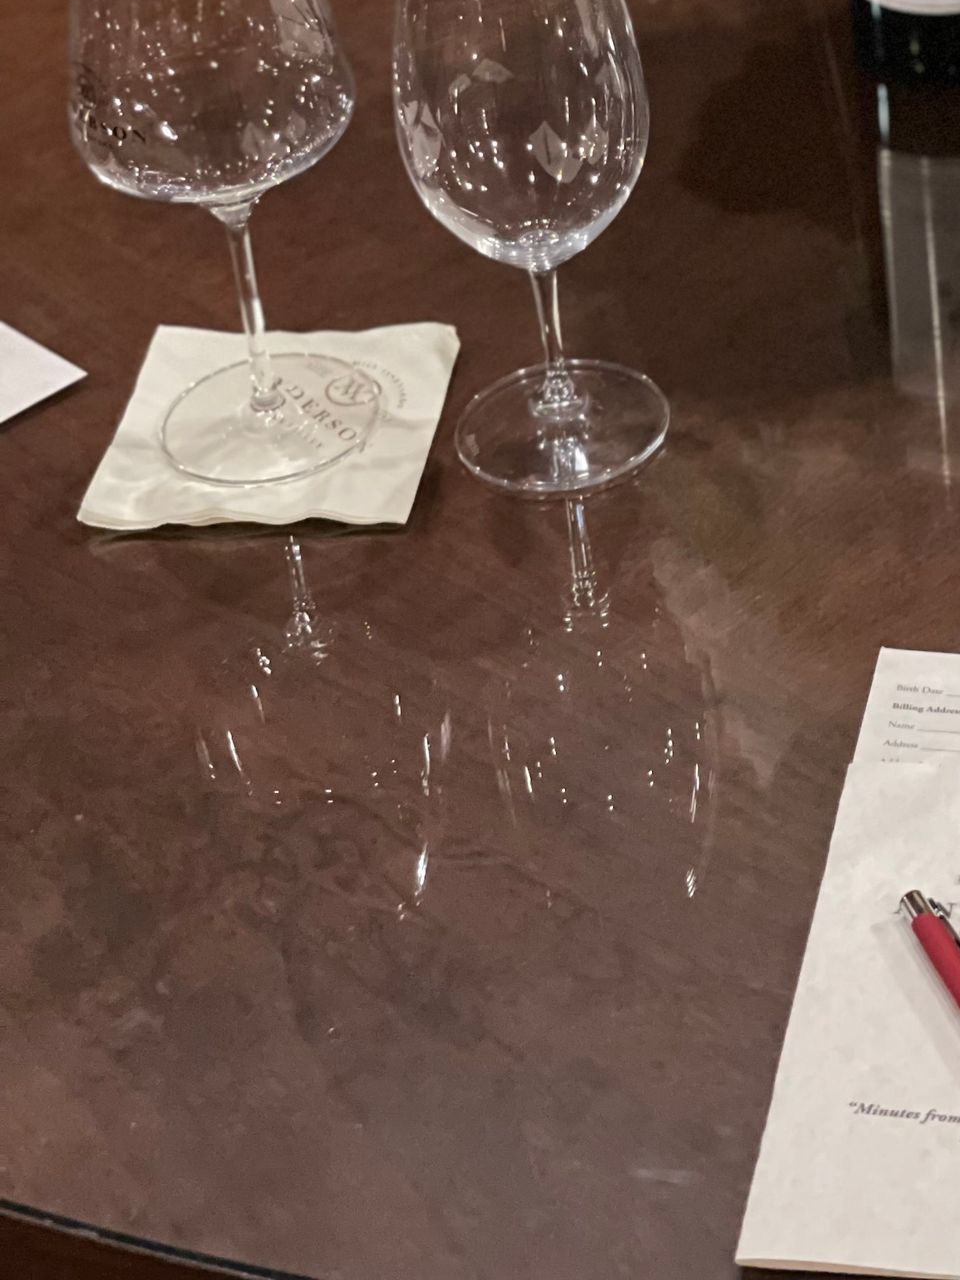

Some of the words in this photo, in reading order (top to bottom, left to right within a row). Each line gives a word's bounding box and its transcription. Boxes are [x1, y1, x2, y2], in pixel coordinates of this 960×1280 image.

[892, 702, 925, 714] Billing
[888, 720, 916, 730] Name
[883, 739, 919, 749] Address
